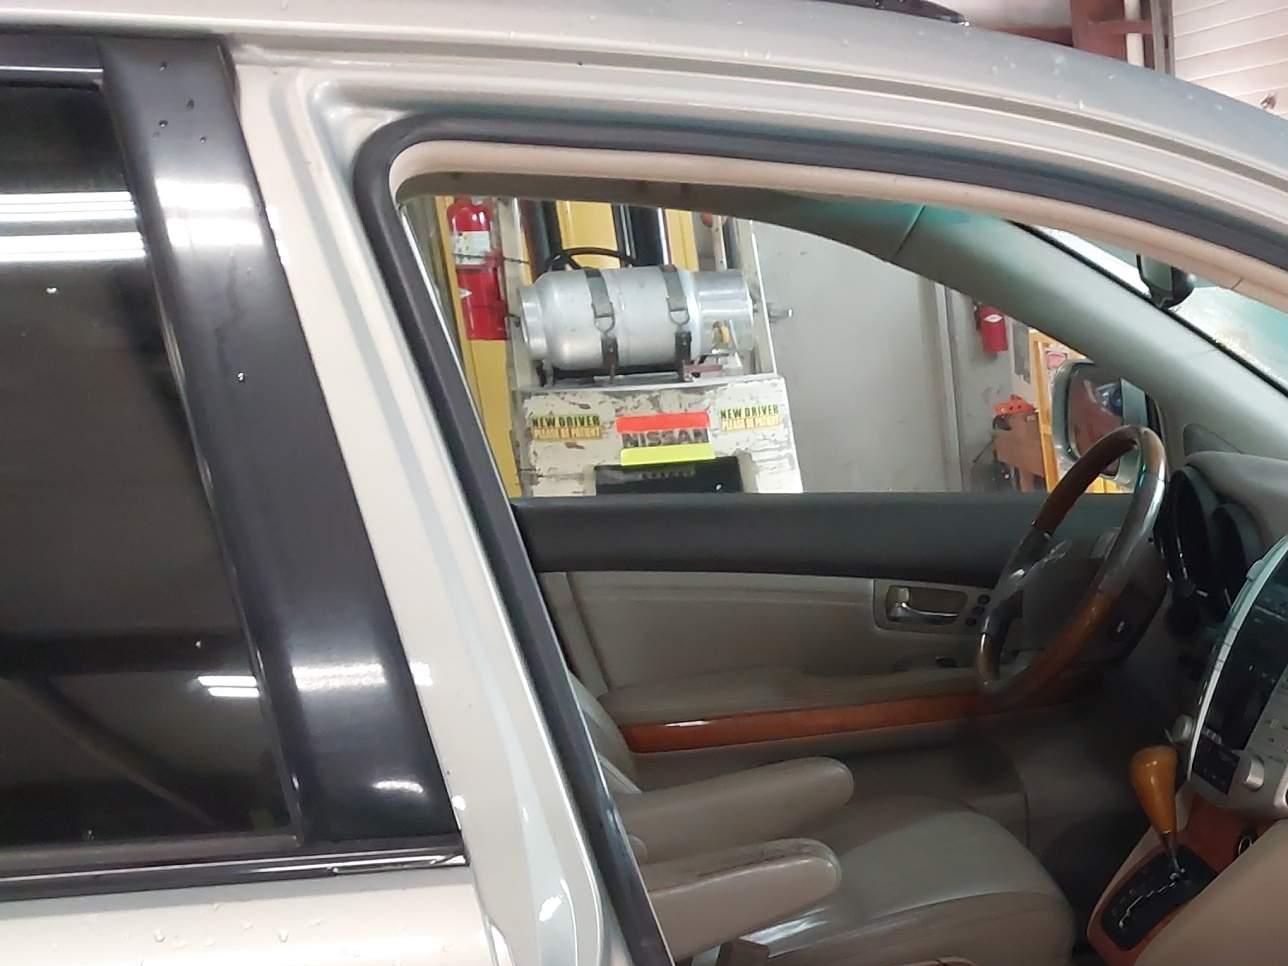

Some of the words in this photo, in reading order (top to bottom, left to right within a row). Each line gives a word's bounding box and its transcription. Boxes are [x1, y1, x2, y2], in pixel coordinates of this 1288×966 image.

[720, 408, 742, 419] NEW
[744, 404, 779, 417] DRIVER
[532, 416, 555, 428] NEW
[558, 415, 600, 427] DRIVER
